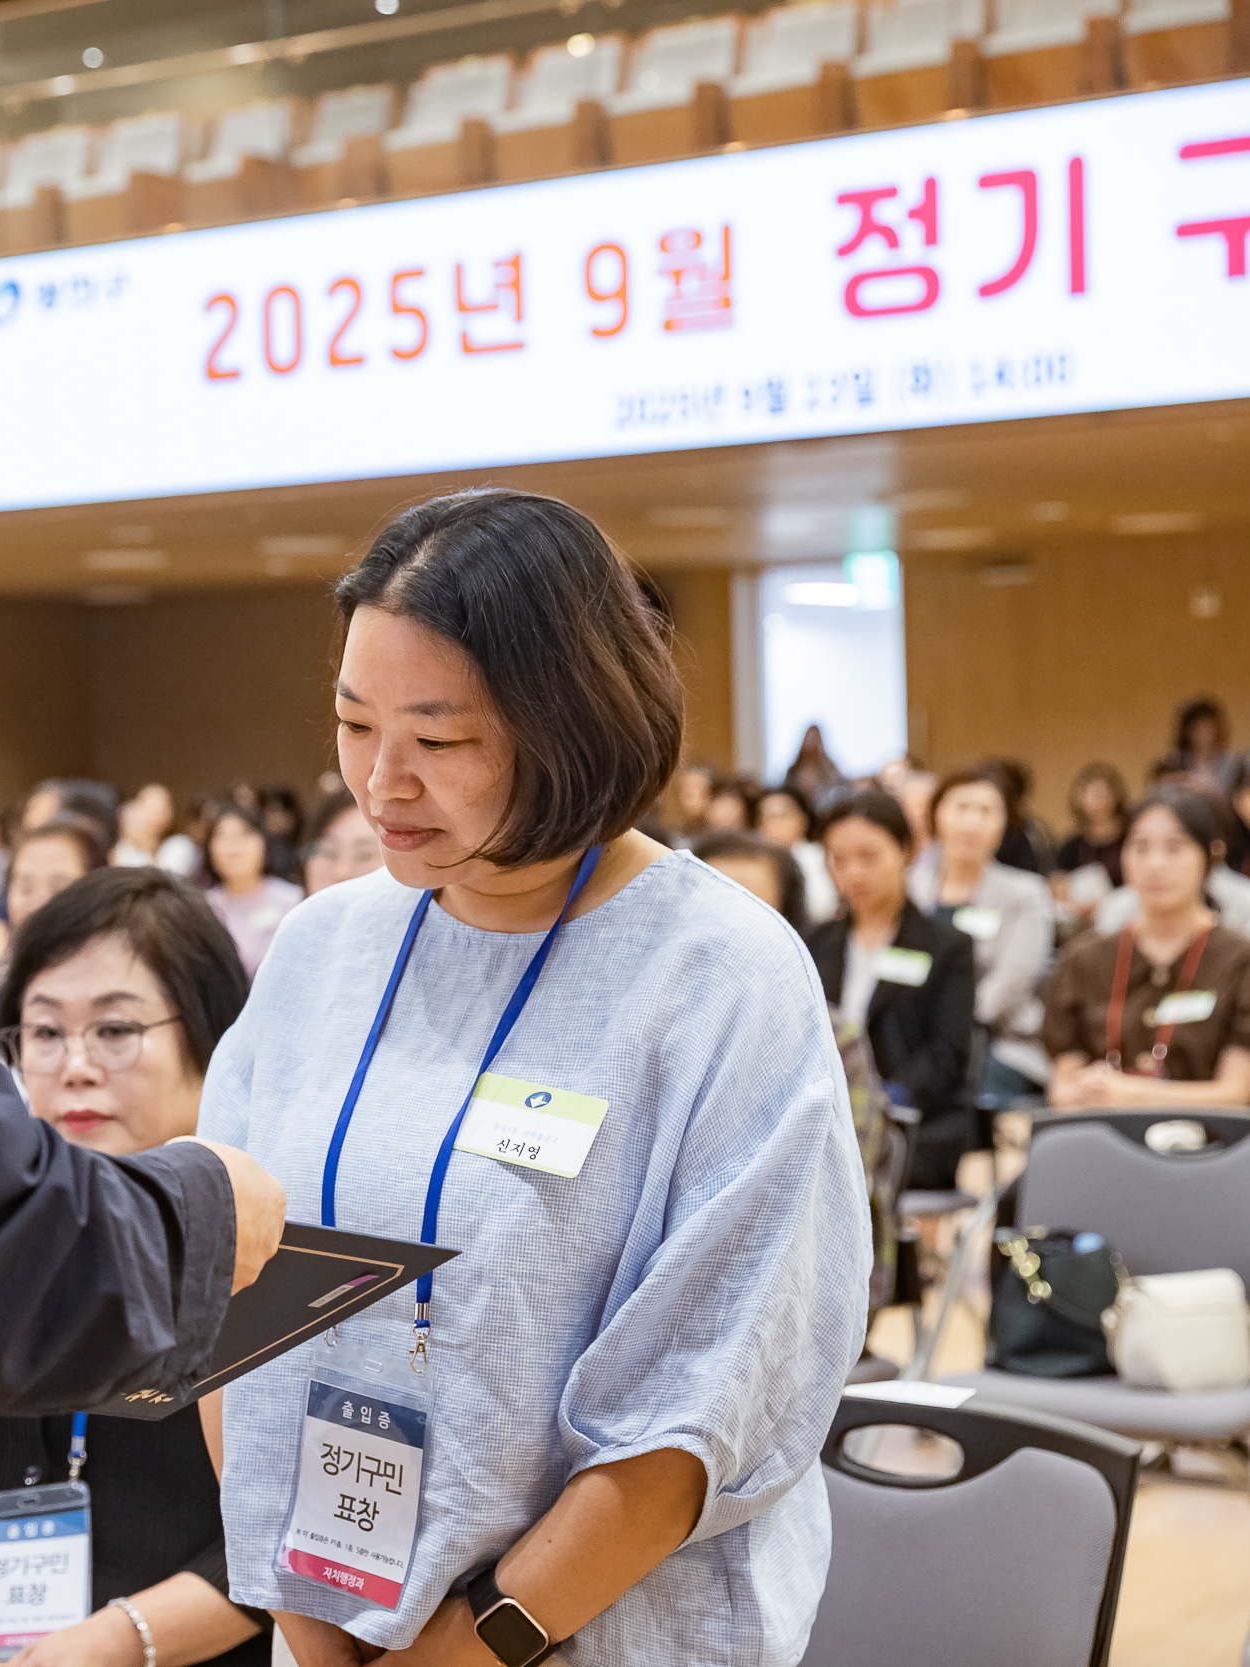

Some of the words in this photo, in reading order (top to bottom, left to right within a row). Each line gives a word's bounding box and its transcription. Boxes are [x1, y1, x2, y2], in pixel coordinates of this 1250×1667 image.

[205, 252, 525, 382] 2025년
[584, 222, 734, 338] 9월
[836, 159, 1087, 320] 정기
[496, 1138, 541, 1160] 신지영
[320, 1442, 403, 1496] 정기구민
[333, 1493, 380, 1532] 표창
[322, 1566, 365, 1590] 자치행정과
[5, 1582, 48, 1607] 표창
